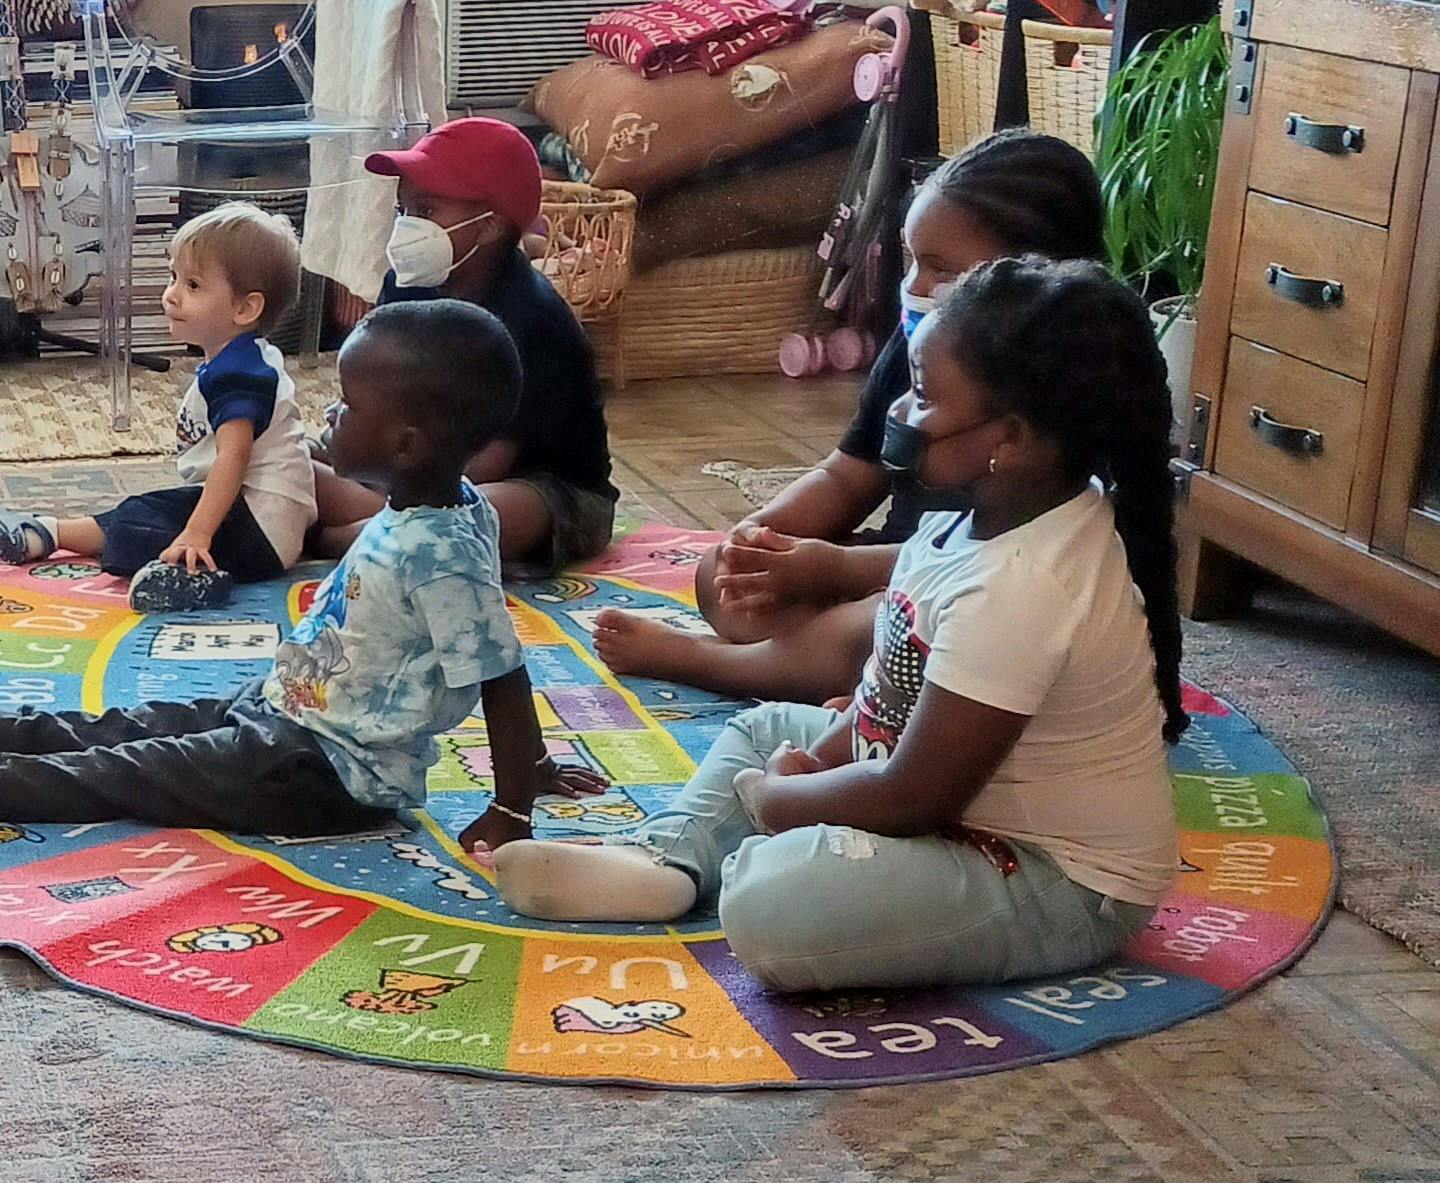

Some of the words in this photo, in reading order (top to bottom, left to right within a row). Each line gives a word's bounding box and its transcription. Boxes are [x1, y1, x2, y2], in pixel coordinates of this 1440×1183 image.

[644, 29, 671, 47] ALL
[693, 4, 716, 15] IS
[705, 11, 733, 30] ALL
[602, 32, 642, 65] LOVE
[13, 605, 106, 632] Dd
[171, 633, 196, 652] March
[206, 634, 241, 649] April
[242, 635, 274, 648] May
[1174, 774, 1284, 830] pizza
[121, 840, 226, 884] Xx
[1190, 839, 1301, 896] quilt
[227, 884, 343, 929] Ww
[373, 931, 487, 976] Vv
[1158, 905, 1261, 963] robot
[87, 937, 255, 998] watch
[543, 953, 689, 991] Uu
[1004, 966, 1168, 1027] seal
[273, 1000, 493, 1048] volcano
[791, 1015, 1006, 1061] tea
[516, 1040, 766, 1062] unicorn
